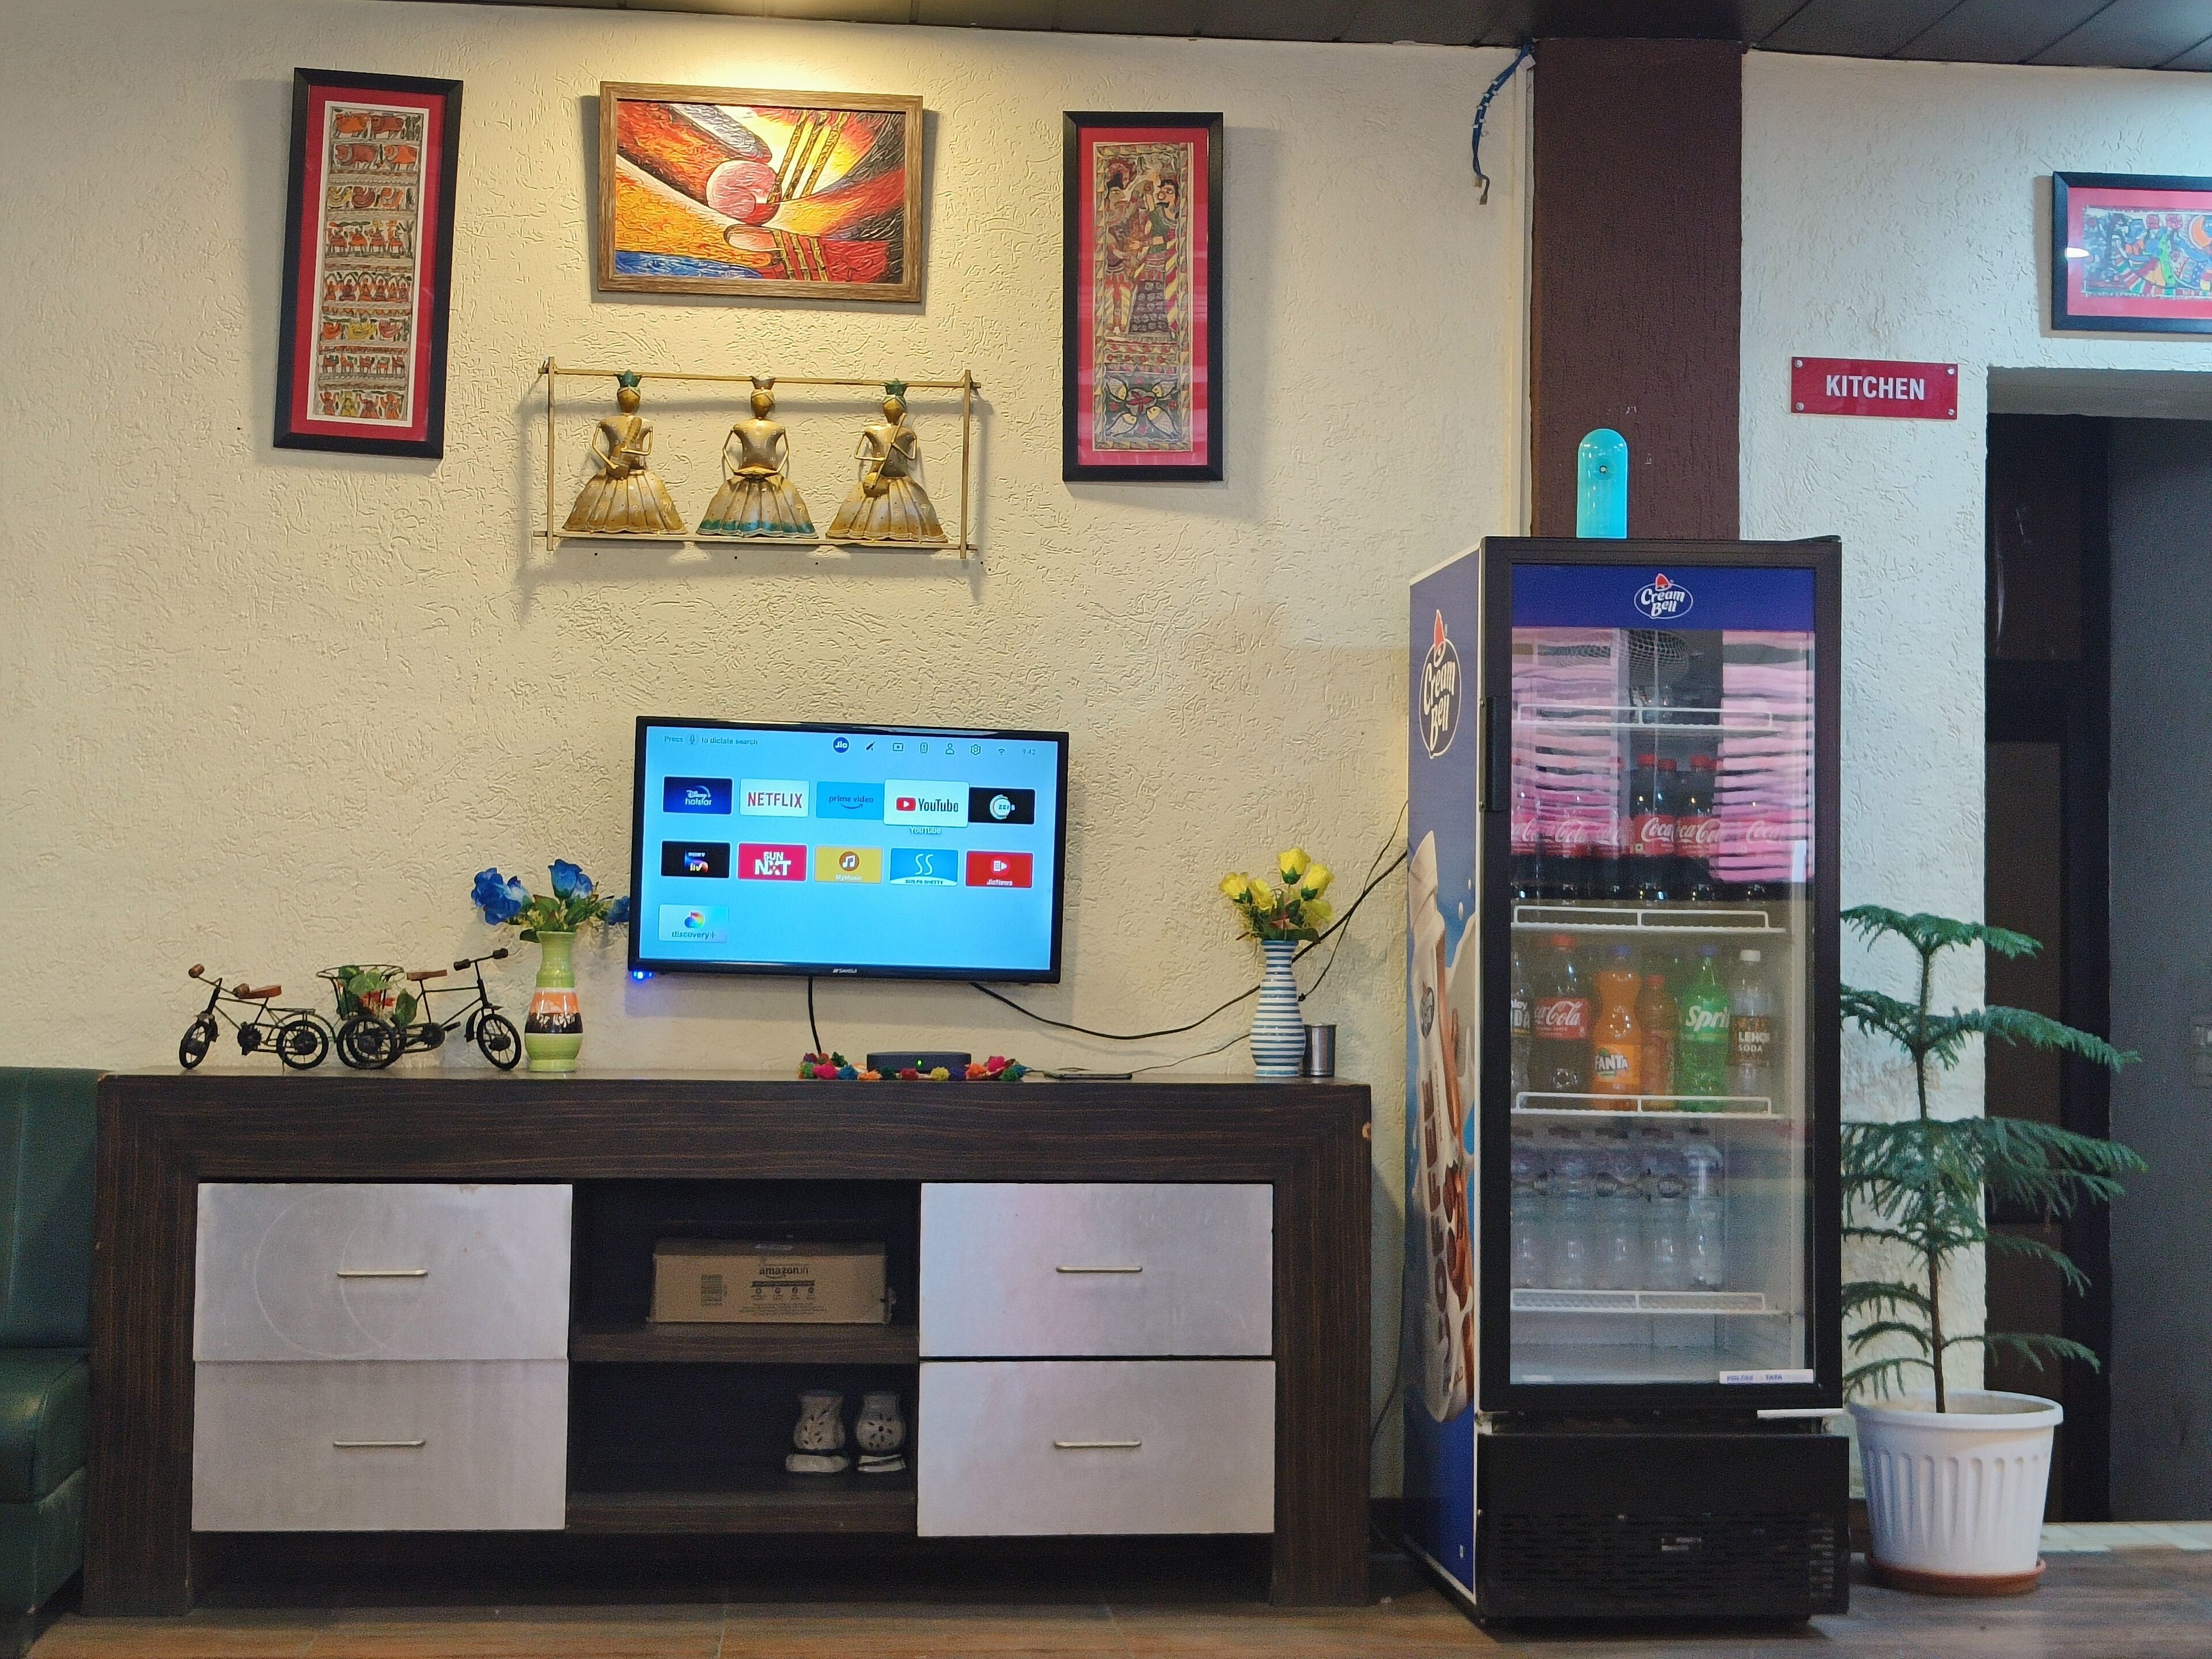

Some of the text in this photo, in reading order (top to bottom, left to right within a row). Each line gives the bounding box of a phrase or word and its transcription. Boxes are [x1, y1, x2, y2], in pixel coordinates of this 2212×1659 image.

[1825, 374, 1925, 400] KITCHEN
[1641, 588, 1685, 605] Cream
[1651, 600, 1677, 617] Bell
[1423, 661, 1456, 715] Cream
[1430, 694, 1450, 752] Bell
[685, 797, 712, 805] hotstar
[747, 792, 802, 808] NETFLIX
[828, 796, 851, 804] prime
[918, 798, 959, 812] YouTube
[909, 827, 942, 835] YouTube
[763, 851, 784, 861] SUN
[754, 859, 791, 876] NXT
[1738, 1044, 1763, 1053] SODA
[759, 1267, 809, 1277] amazon.in
